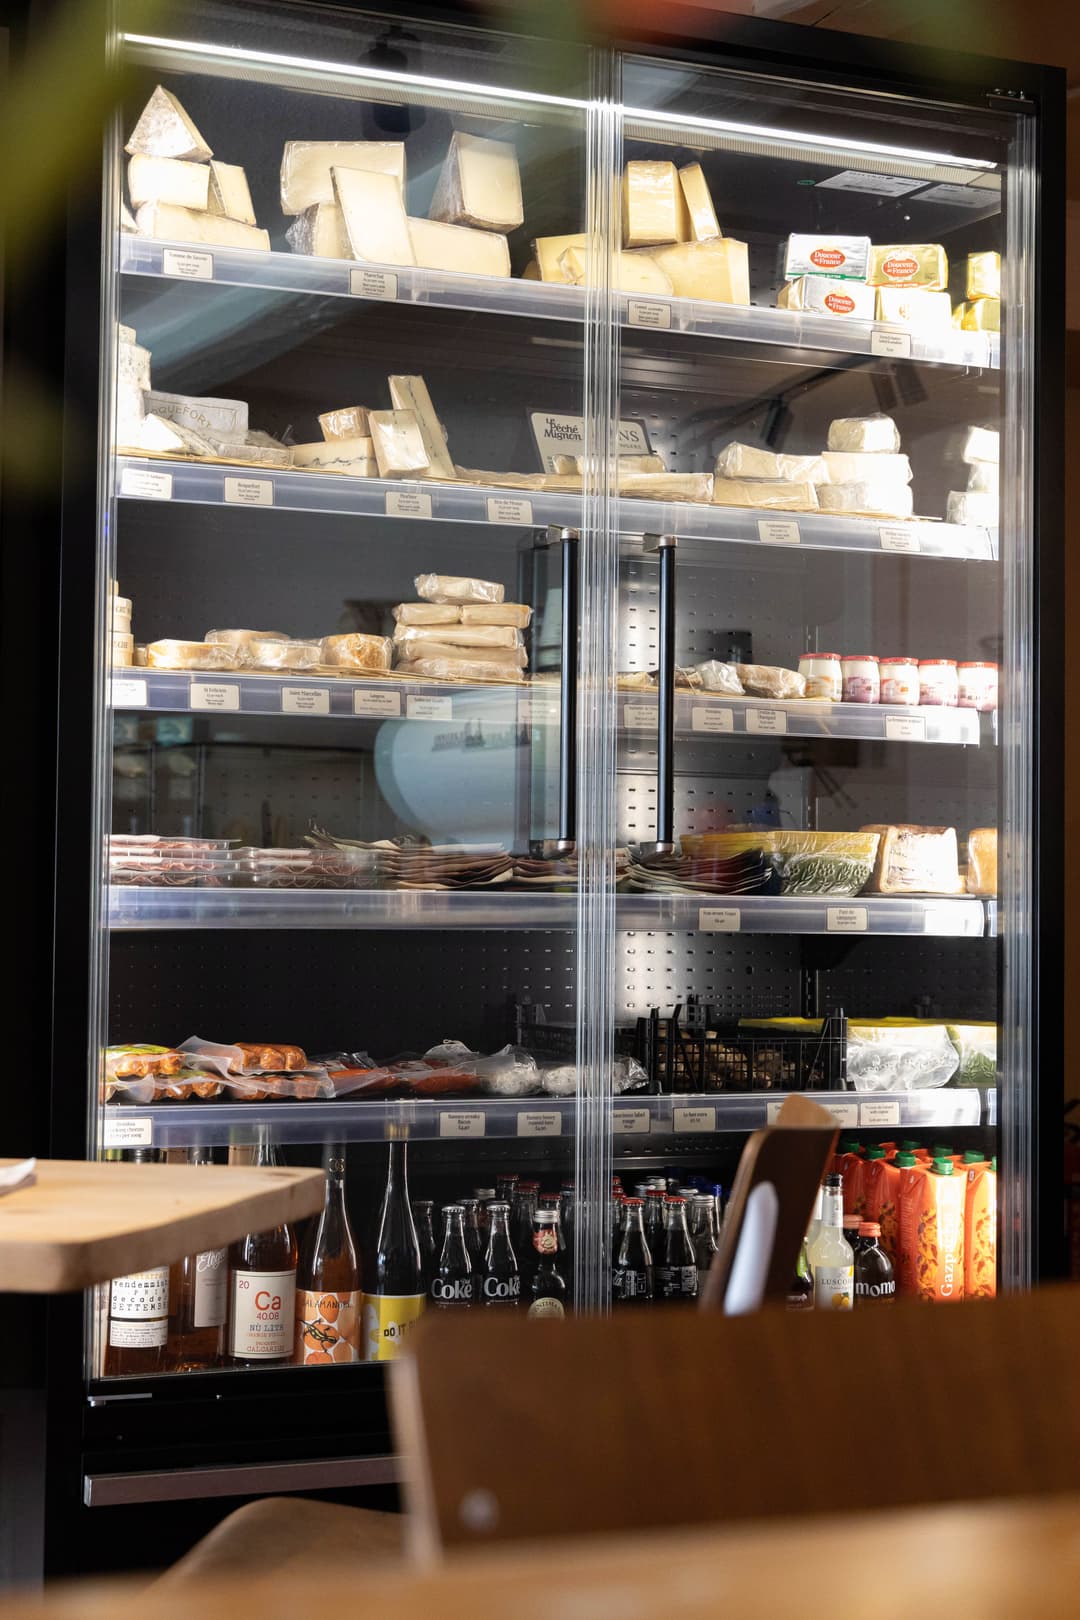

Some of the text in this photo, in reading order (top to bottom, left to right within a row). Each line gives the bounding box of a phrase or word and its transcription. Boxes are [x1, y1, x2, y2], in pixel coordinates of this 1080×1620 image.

[829, 295, 851, 304] Douceur
[833, 302, 852, 310] France
[145, 405, 211, 428] OQUEFORT
[550, 422, 579, 434] Péché
[544, 429, 582, 441] Mignon
[619, 429, 640, 443] NS
[238, 1280, 250, 1290] 20
[431, 1277, 472, 1299] Coke
[483, 1275, 520, 1297] Coke
[855, 1280, 896, 1297] momo
[255, 1290, 282, 1311] Ca
[256, 1312, 280, 1321] 40.08
[384, 1328, 395, 1337] DO
